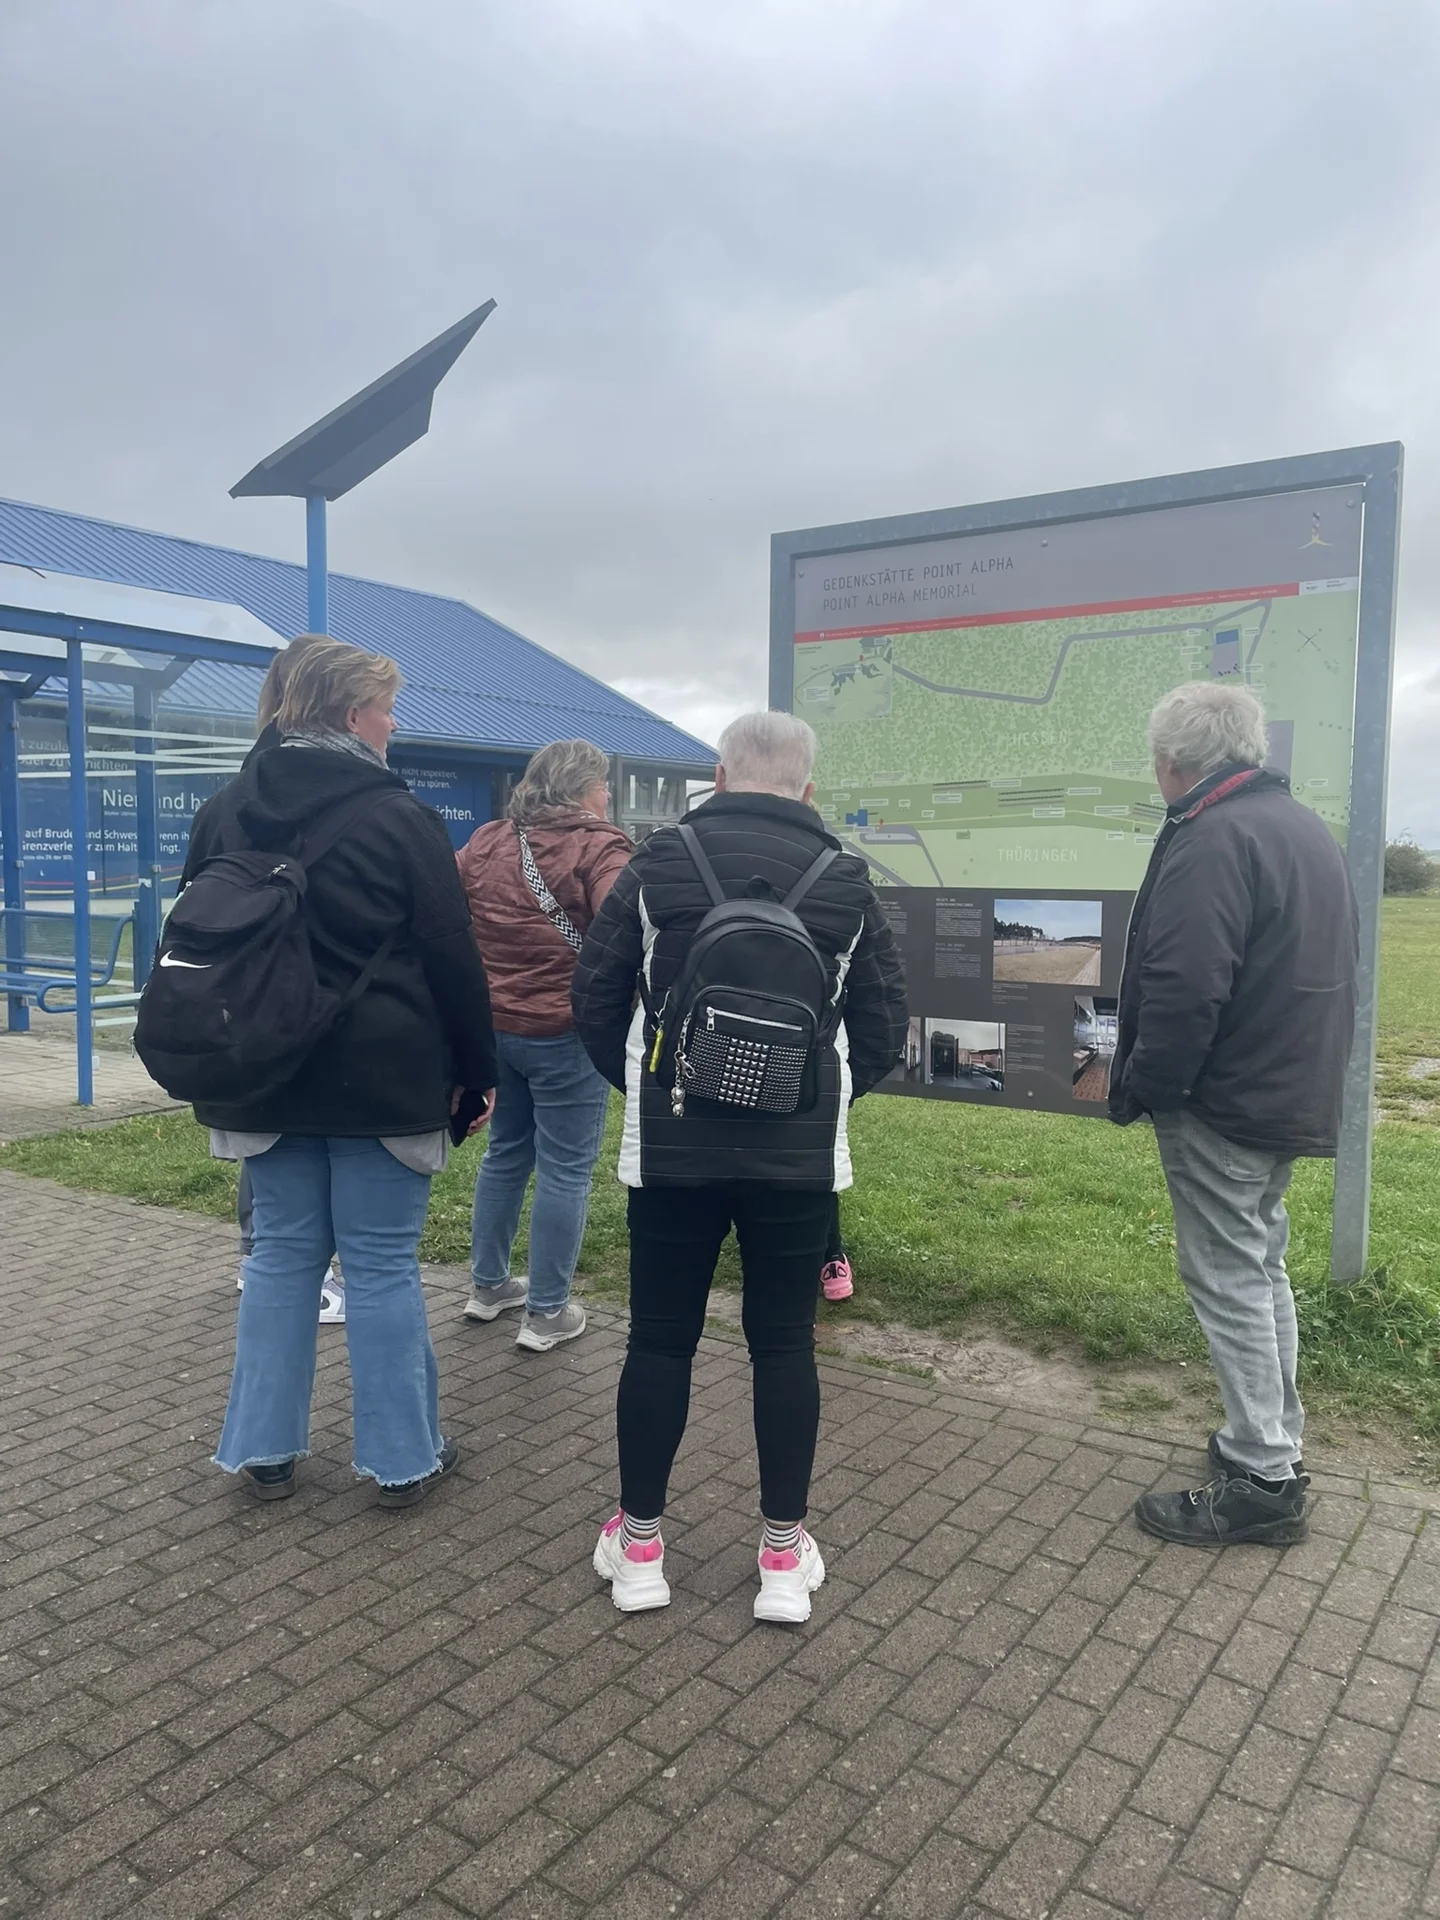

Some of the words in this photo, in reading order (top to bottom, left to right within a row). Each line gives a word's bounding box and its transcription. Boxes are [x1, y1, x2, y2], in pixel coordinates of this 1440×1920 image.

[823, 568, 915, 592] GEDENKSTÄTTE
[923, 562, 963, 580] POINT
[970, 556, 1015, 574] ALPHA
[823, 595, 858, 611] POINT
[866, 591, 906, 607] ALPHA
[913, 583, 978, 602] MEMORIAL
[1012, 731, 1068, 746] HESSEN
[417, 780, 426, 788] zu
[426, 779, 452, 790] spüren.
[25, 827, 42, 839] auf
[997, 845, 1078, 862] THÜRINGEN
